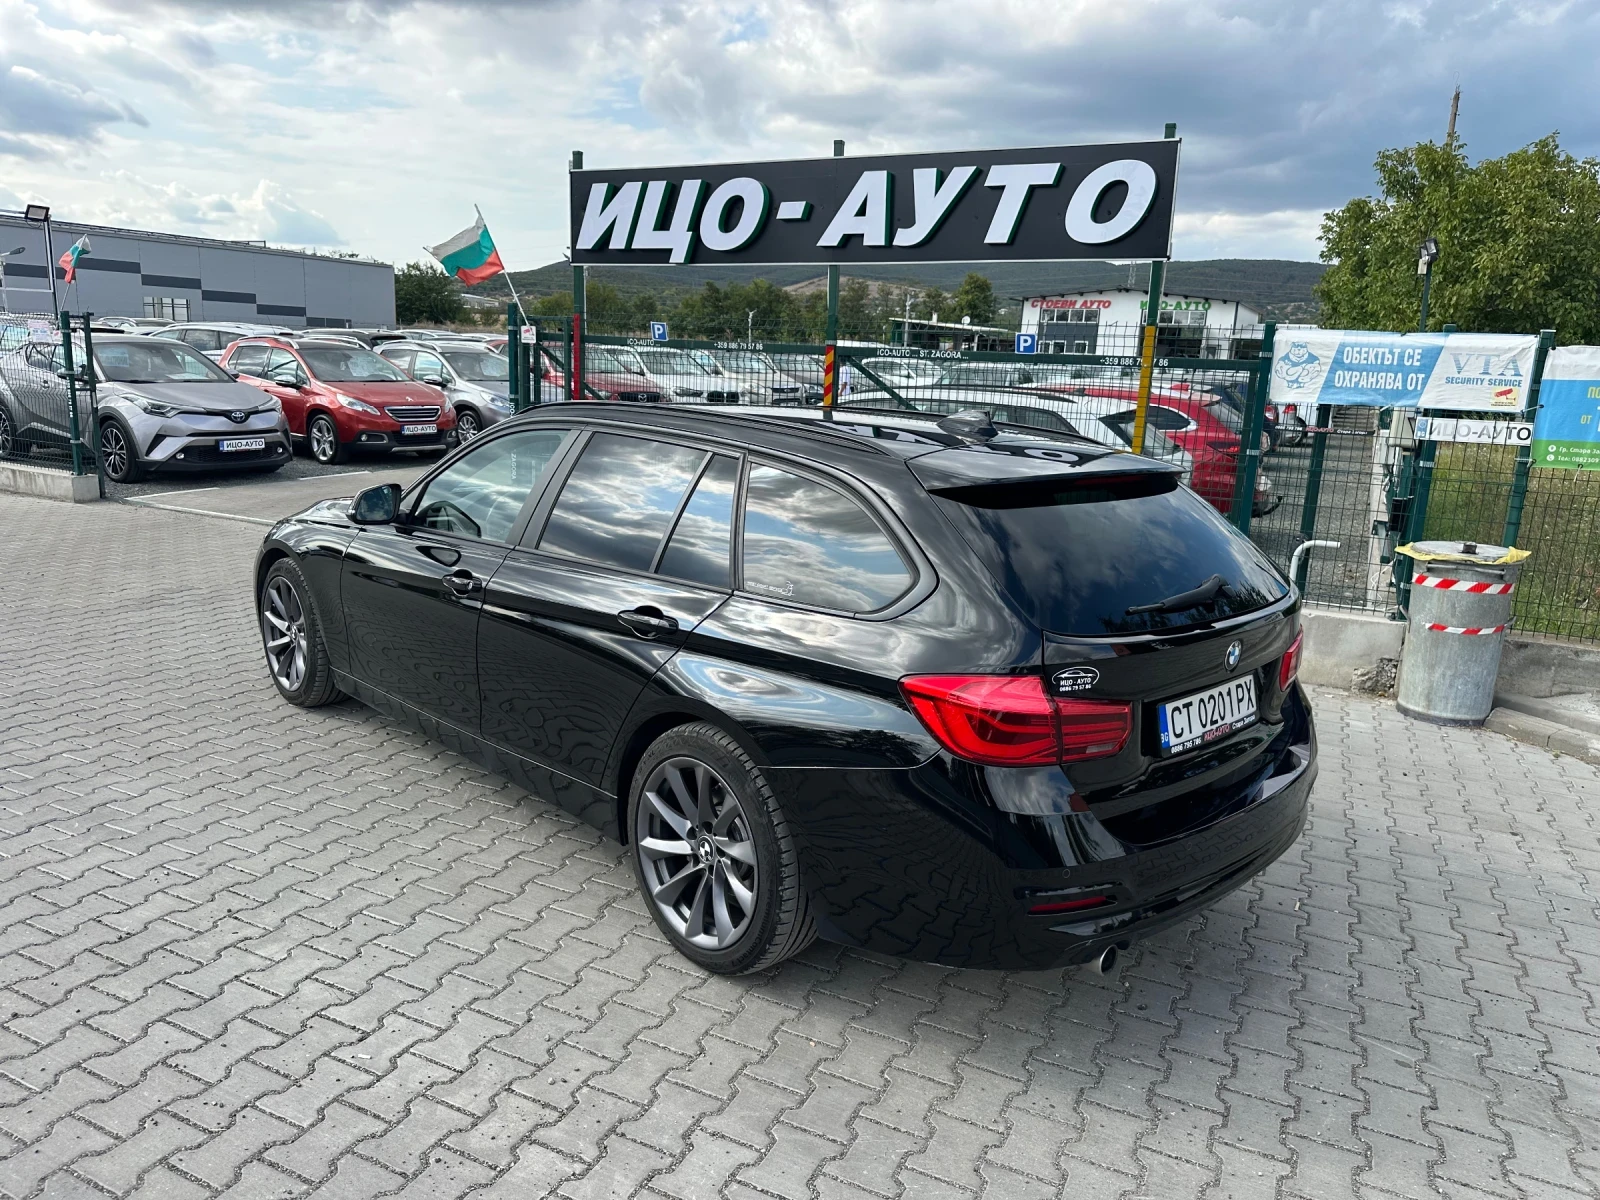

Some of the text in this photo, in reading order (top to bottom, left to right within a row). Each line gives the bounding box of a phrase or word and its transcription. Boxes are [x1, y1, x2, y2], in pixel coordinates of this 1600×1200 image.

[1030, 299, 1112, 309] СТОЕВИ АУТО
[1140, 300, 1212, 310] ИО-АУТО
[654, 325, 664, 338] P
[1020, 335, 1031, 351] P
[920, 350, 930, 358] ST.
[931, 350, 962, 359] ZAGORA
[1343, 346, 1423, 366] ОБЕКТЪТ СЕ
[1100, 357, 1118, 365] +359
[1120, 358, 1134, 366] 886
[1159, 359, 1169, 367] 86
[1450, 353, 1523, 377] VTA
[1334, 370, 1425, 391] ОХРАНЯВА ОТ
[1445, 376, 1523, 388] SECURITY SERVICE
[405, 425, 437, 433] ИЦО-АУТО
[1430, 422, 1532, 441] ИЦО-АУТО
[226, 440, 263, 449] ИЦО-АУТО
